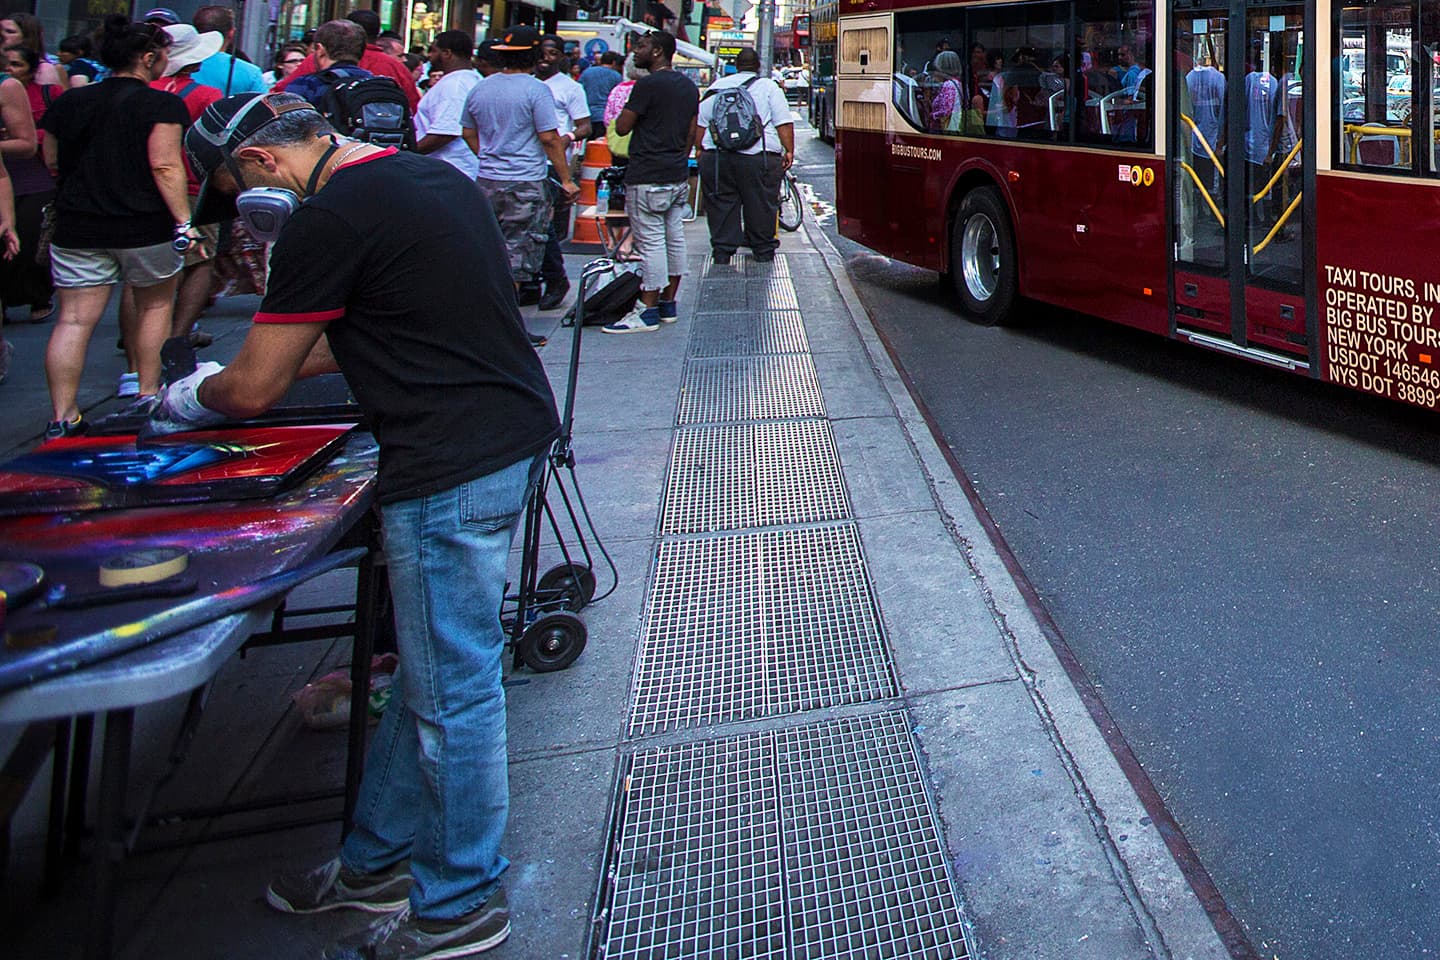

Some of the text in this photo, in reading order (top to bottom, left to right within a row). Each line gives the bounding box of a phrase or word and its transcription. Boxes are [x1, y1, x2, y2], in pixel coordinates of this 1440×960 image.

[891, 143, 943, 161] BIGBUSTOURS.COM
[1325, 265, 1356, 288] TAXI
[1360, 271, 1420, 303] TOURS,
[1326, 288, 1434, 326] OPERATED BY
[1327, 307, 1352, 328] BIG
[1356, 313, 1387, 336] BUS
[1327, 326, 1409, 362] NEW YORK
[1328, 344, 1379, 374] USDOT
[1329, 364, 1358, 387] NYS
[1362, 372, 1393, 397] DOT
